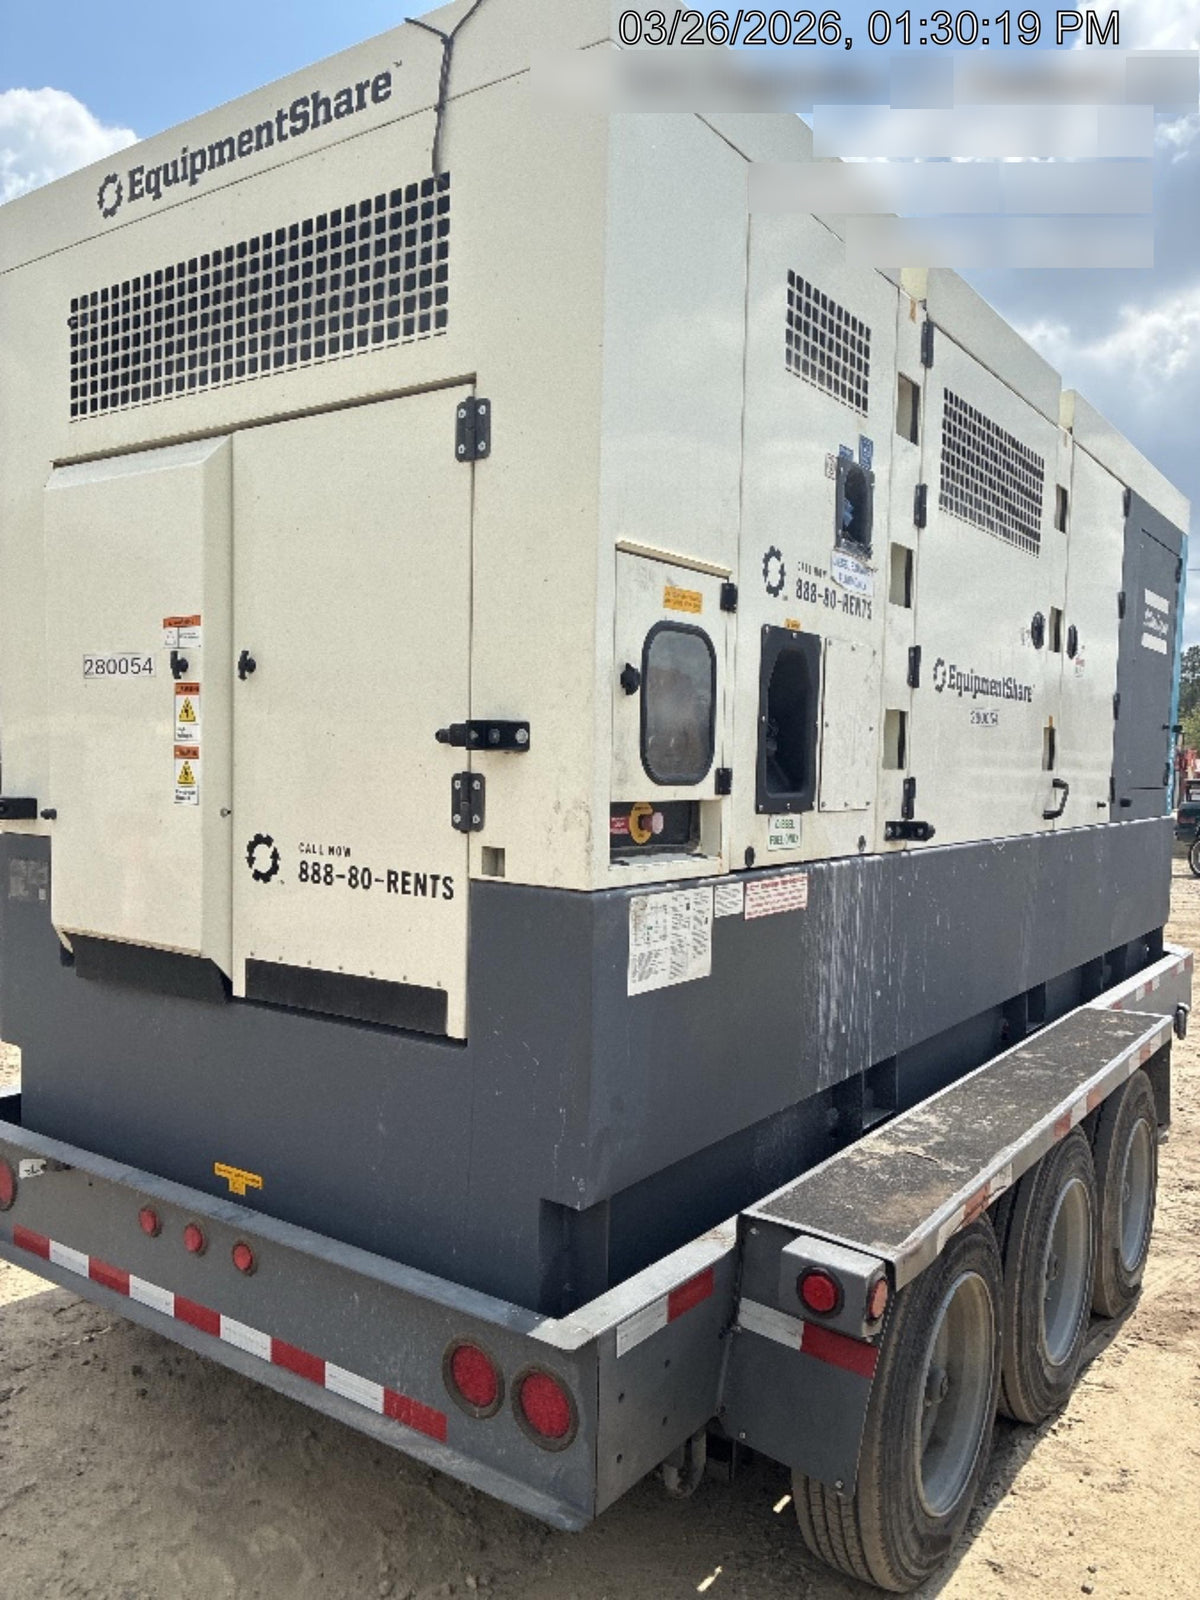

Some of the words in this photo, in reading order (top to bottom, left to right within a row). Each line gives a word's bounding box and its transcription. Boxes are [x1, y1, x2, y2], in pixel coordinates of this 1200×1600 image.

[127, 70, 393, 203] EquipmentShare
[83, 656, 154, 676] 280054
[947, 664, 1033, 703] EquipmentShare
[299, 842, 325, 856] CALL
[328, 848, 351, 858] NOW
[299, 860, 455, 901] 888-80-RENTS
